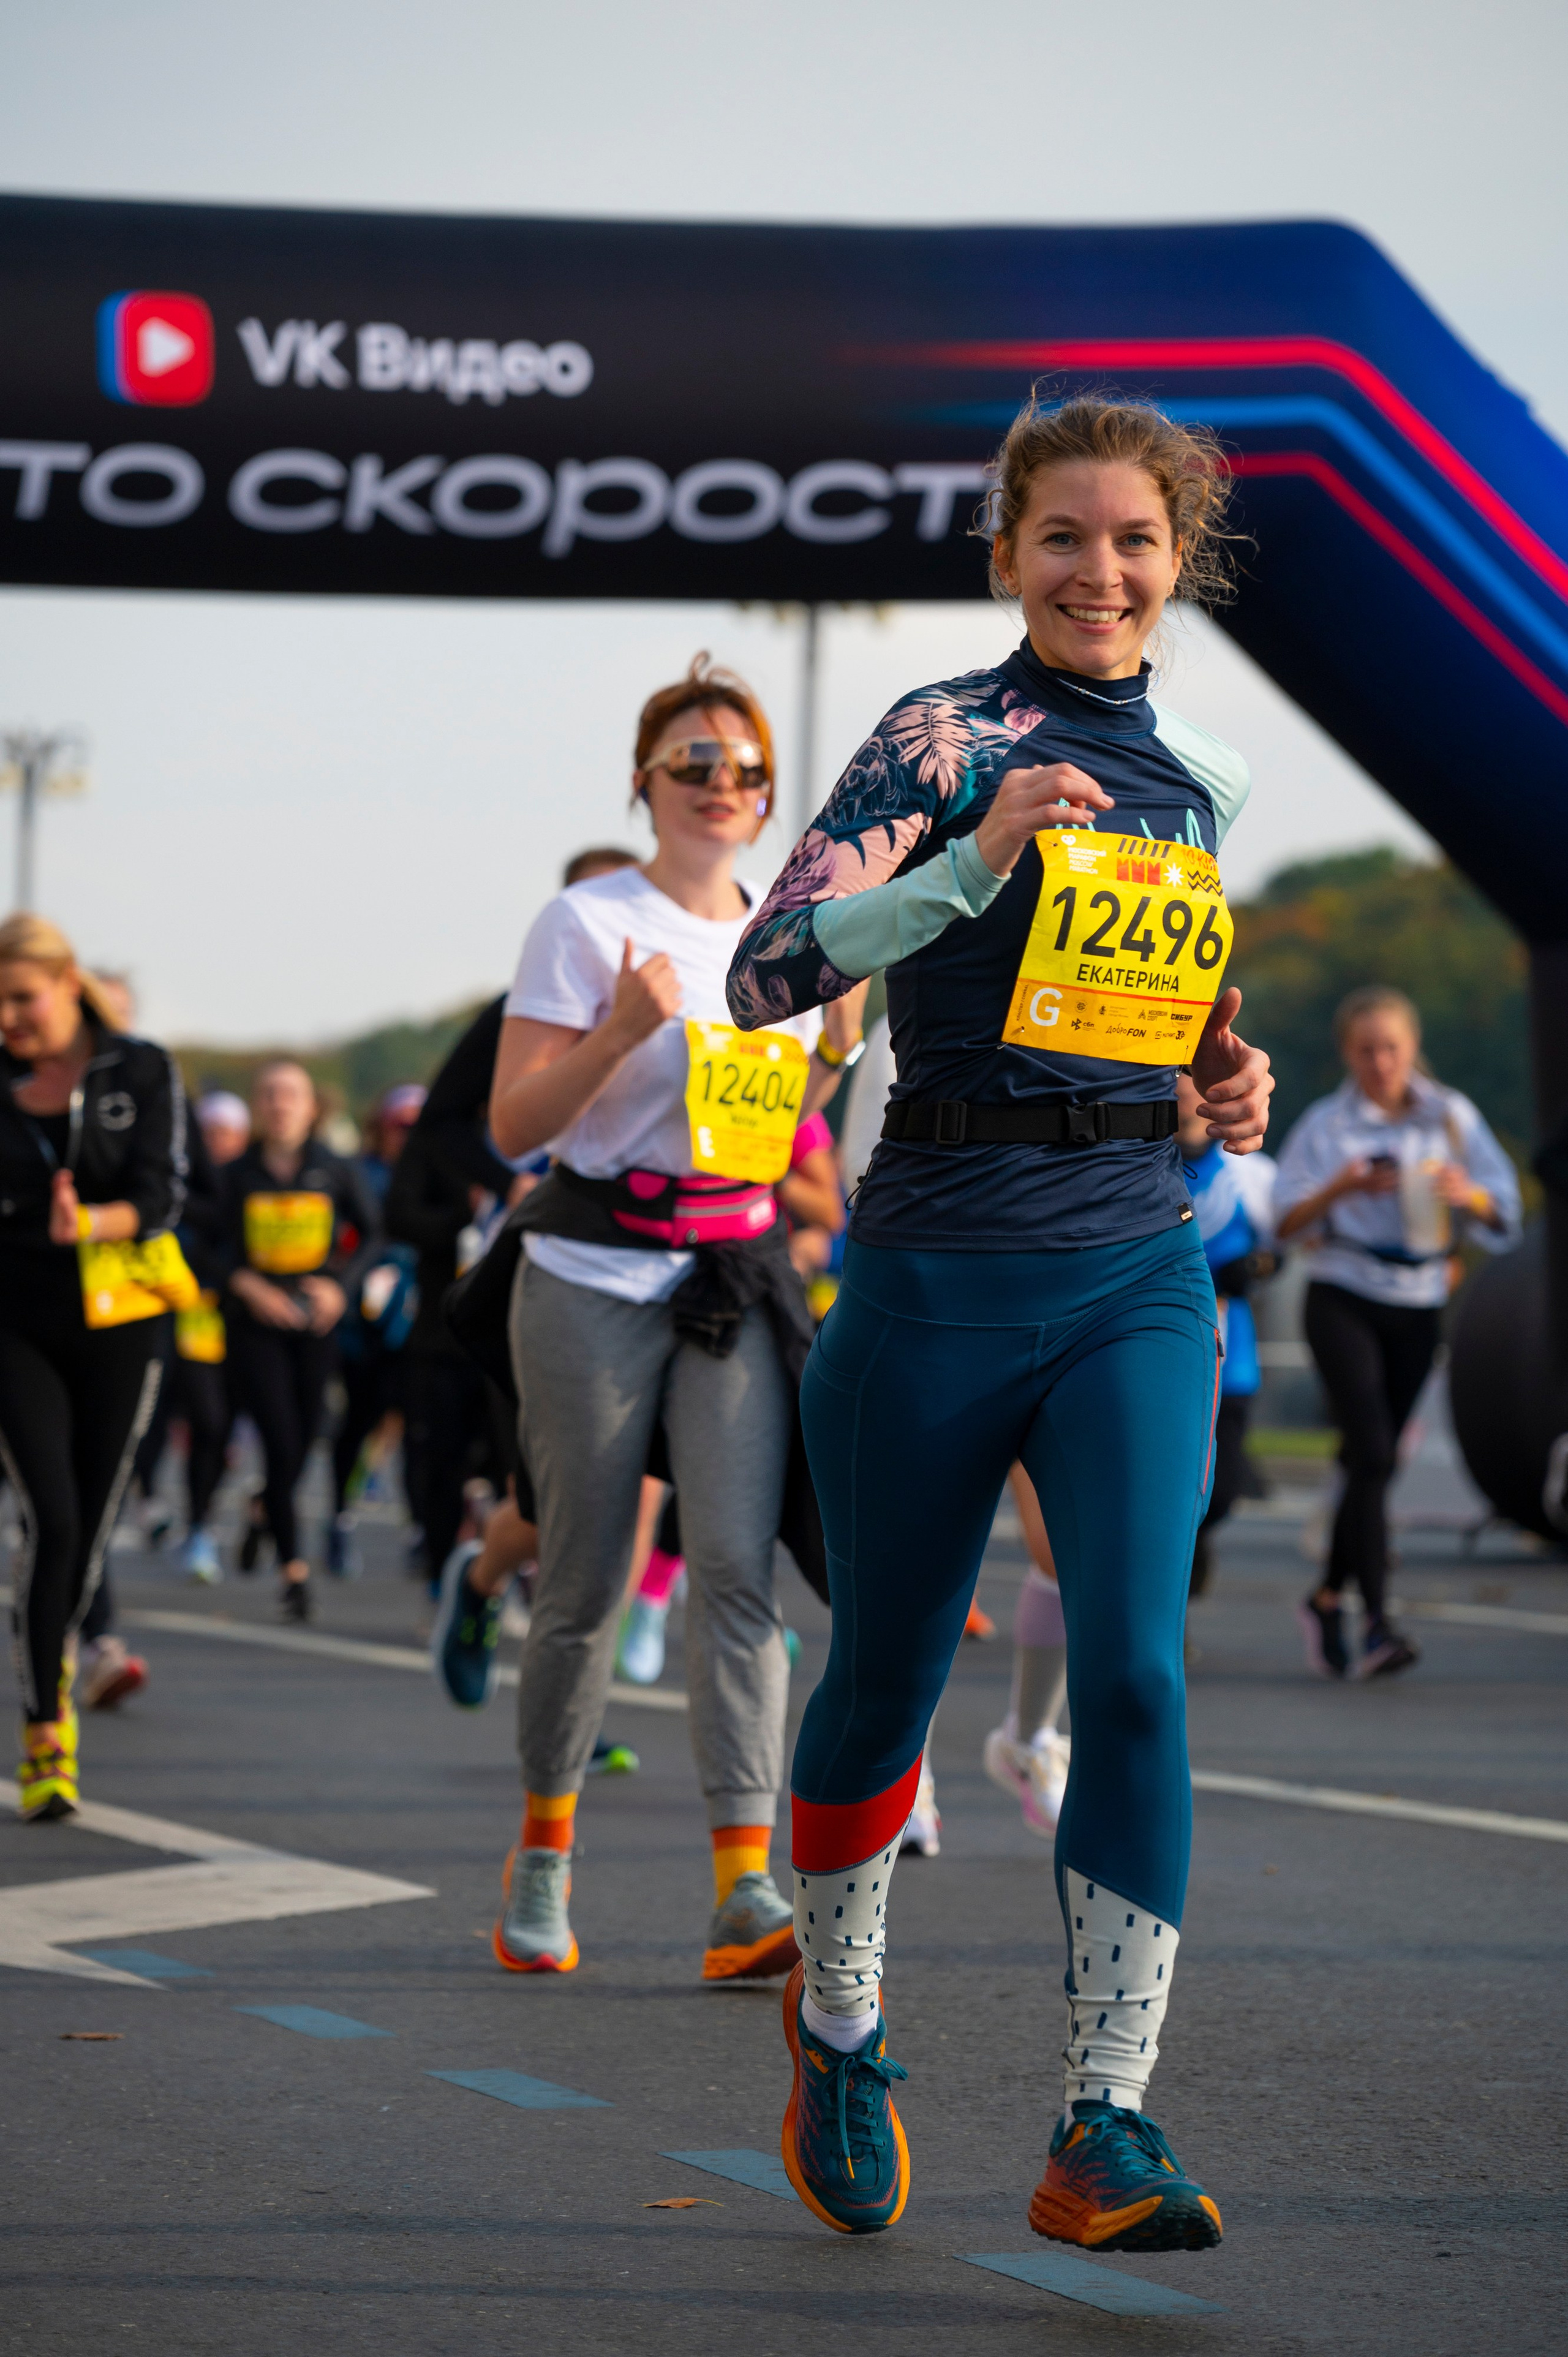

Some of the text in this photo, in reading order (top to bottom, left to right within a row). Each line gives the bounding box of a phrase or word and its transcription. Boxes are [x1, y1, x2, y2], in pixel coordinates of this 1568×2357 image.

[236, 316, 594, 407] VK Видео
[1052, 886, 1223, 970] 12496
[1077, 963, 1179, 992] ЕКАТЕРИНА
[1030, 987, 1063, 1027] G
[1170, 1013, 1193, 1022] СИБУР
[703, 1060, 798, 1113] 12404
